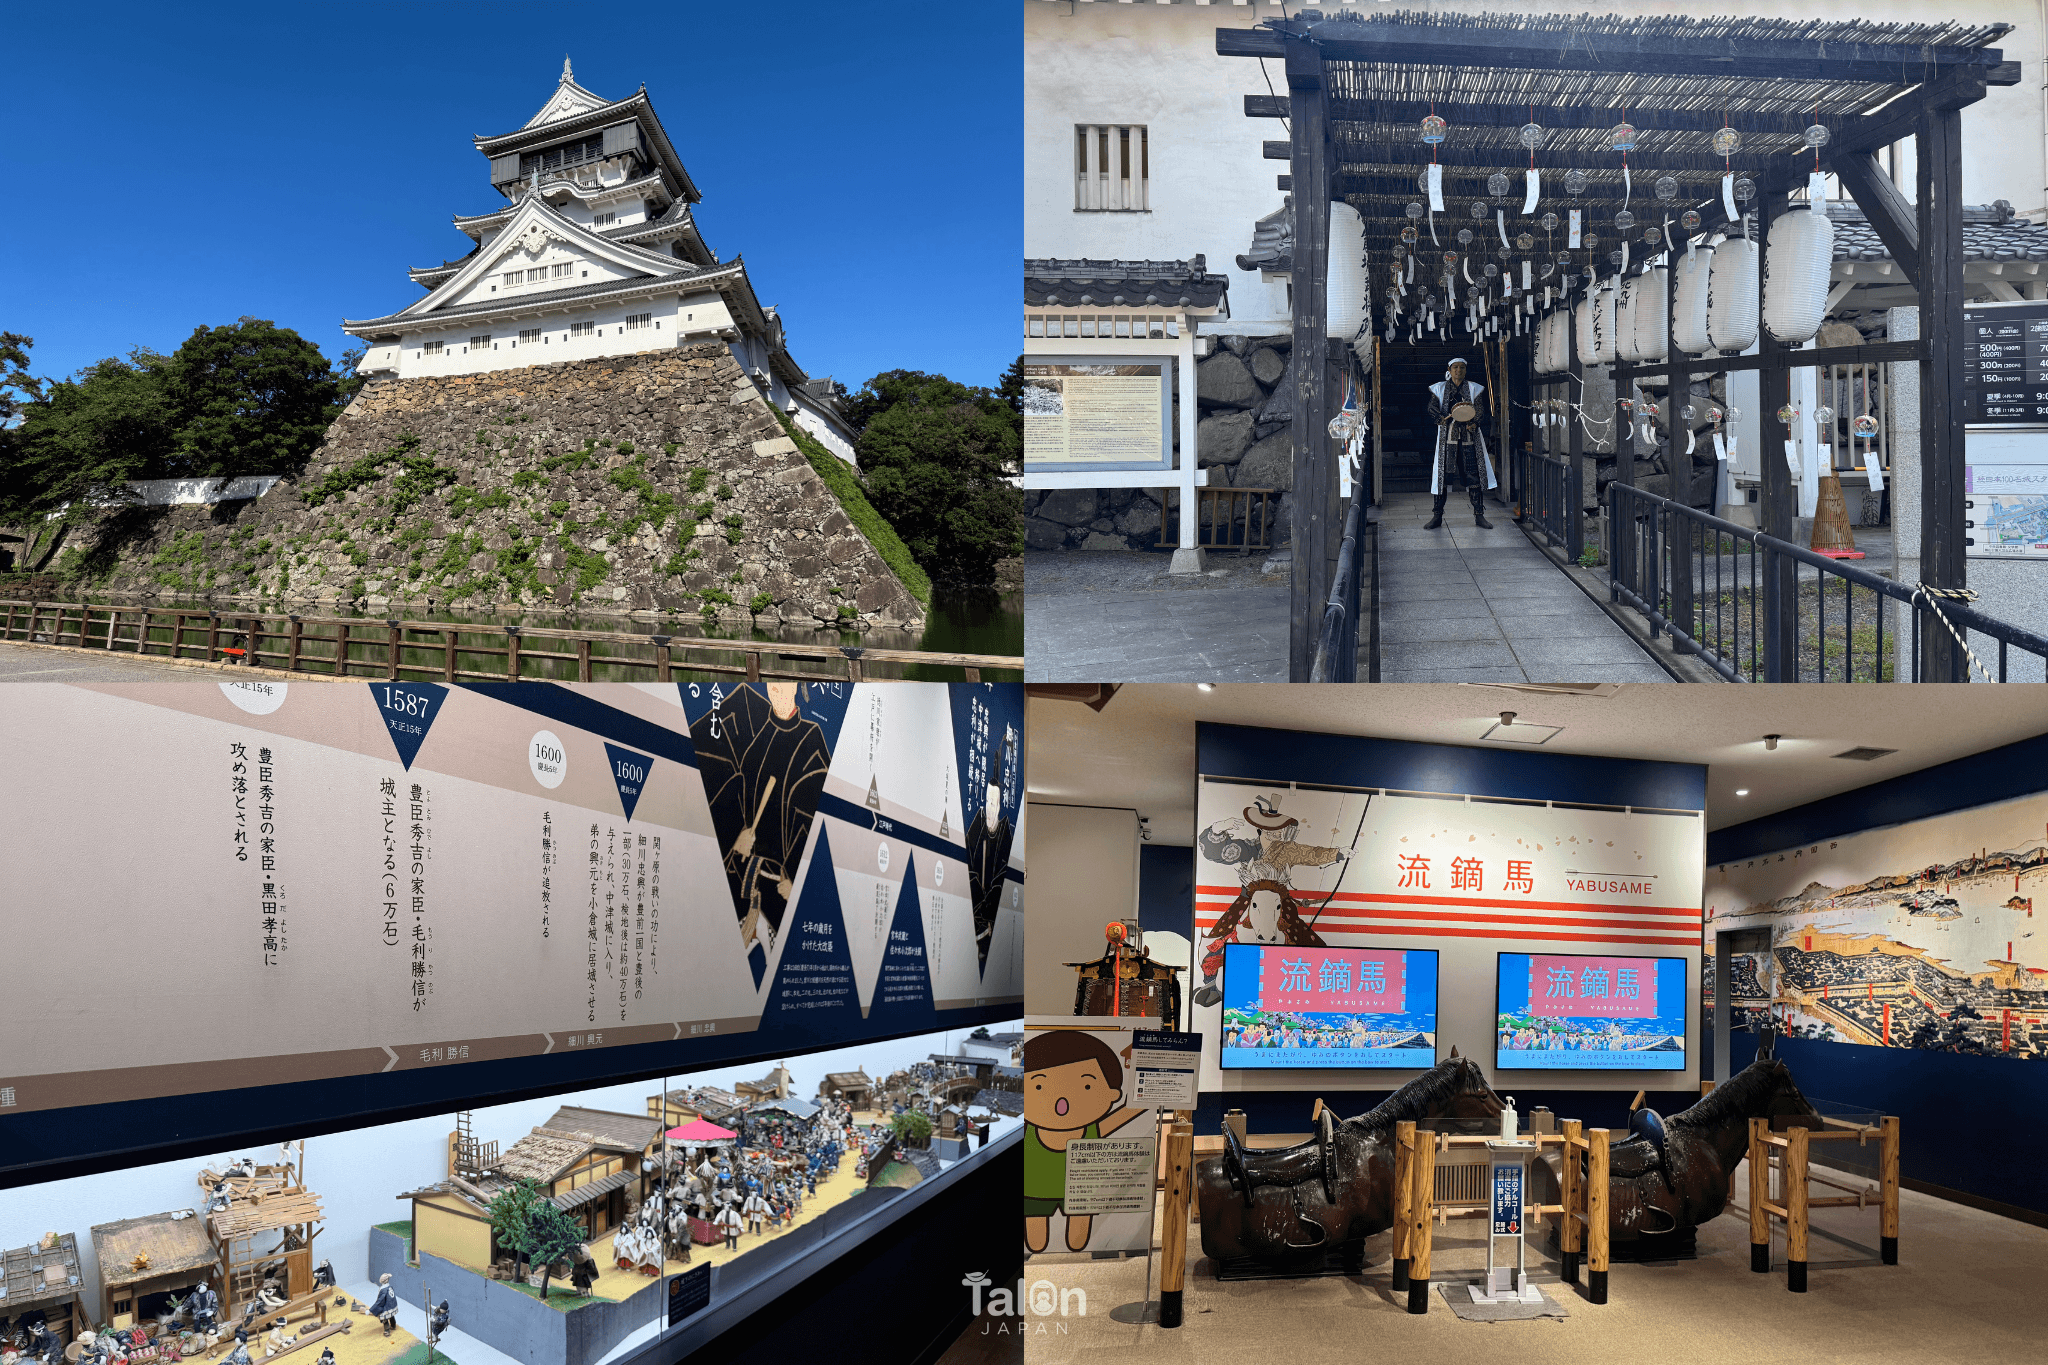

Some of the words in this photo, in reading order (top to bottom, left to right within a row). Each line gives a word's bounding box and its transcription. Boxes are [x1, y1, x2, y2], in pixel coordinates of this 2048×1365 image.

[1980, 344, 2002, 352] 500円
[1980, 361, 2003, 369] 300円
[1981, 374, 2003, 382] 150円
[383, 686, 429, 719] 1587
[389, 719, 422, 736] 天正15年
[535, 743, 562, 764] 1600
[616, 760, 643, 783] 1600
[230, 742, 249, 862] 攻め落とされる
[258, 747, 278, 966] 豊臣秀吉の家臣・黒田孝高に
[542, 811, 551, 939] 毛利勝信が追放される
[1396, 853, 1534, 895] 流鏑馬
[409, 784, 426, 1012] 豊臣秀吉の家臣・毛利勝信が
[1566, 878, 1652, 895] YABUSAME
[1278, 957, 1387, 995] 流鏑馬
[1545, 965, 1641, 1001] 流鏑馬
[420, 1047, 443, 1063] 毛利
[447, 1045, 469, 1060] 勝信
[1071, 1142, 1144, 1151] 身長制限があります。
